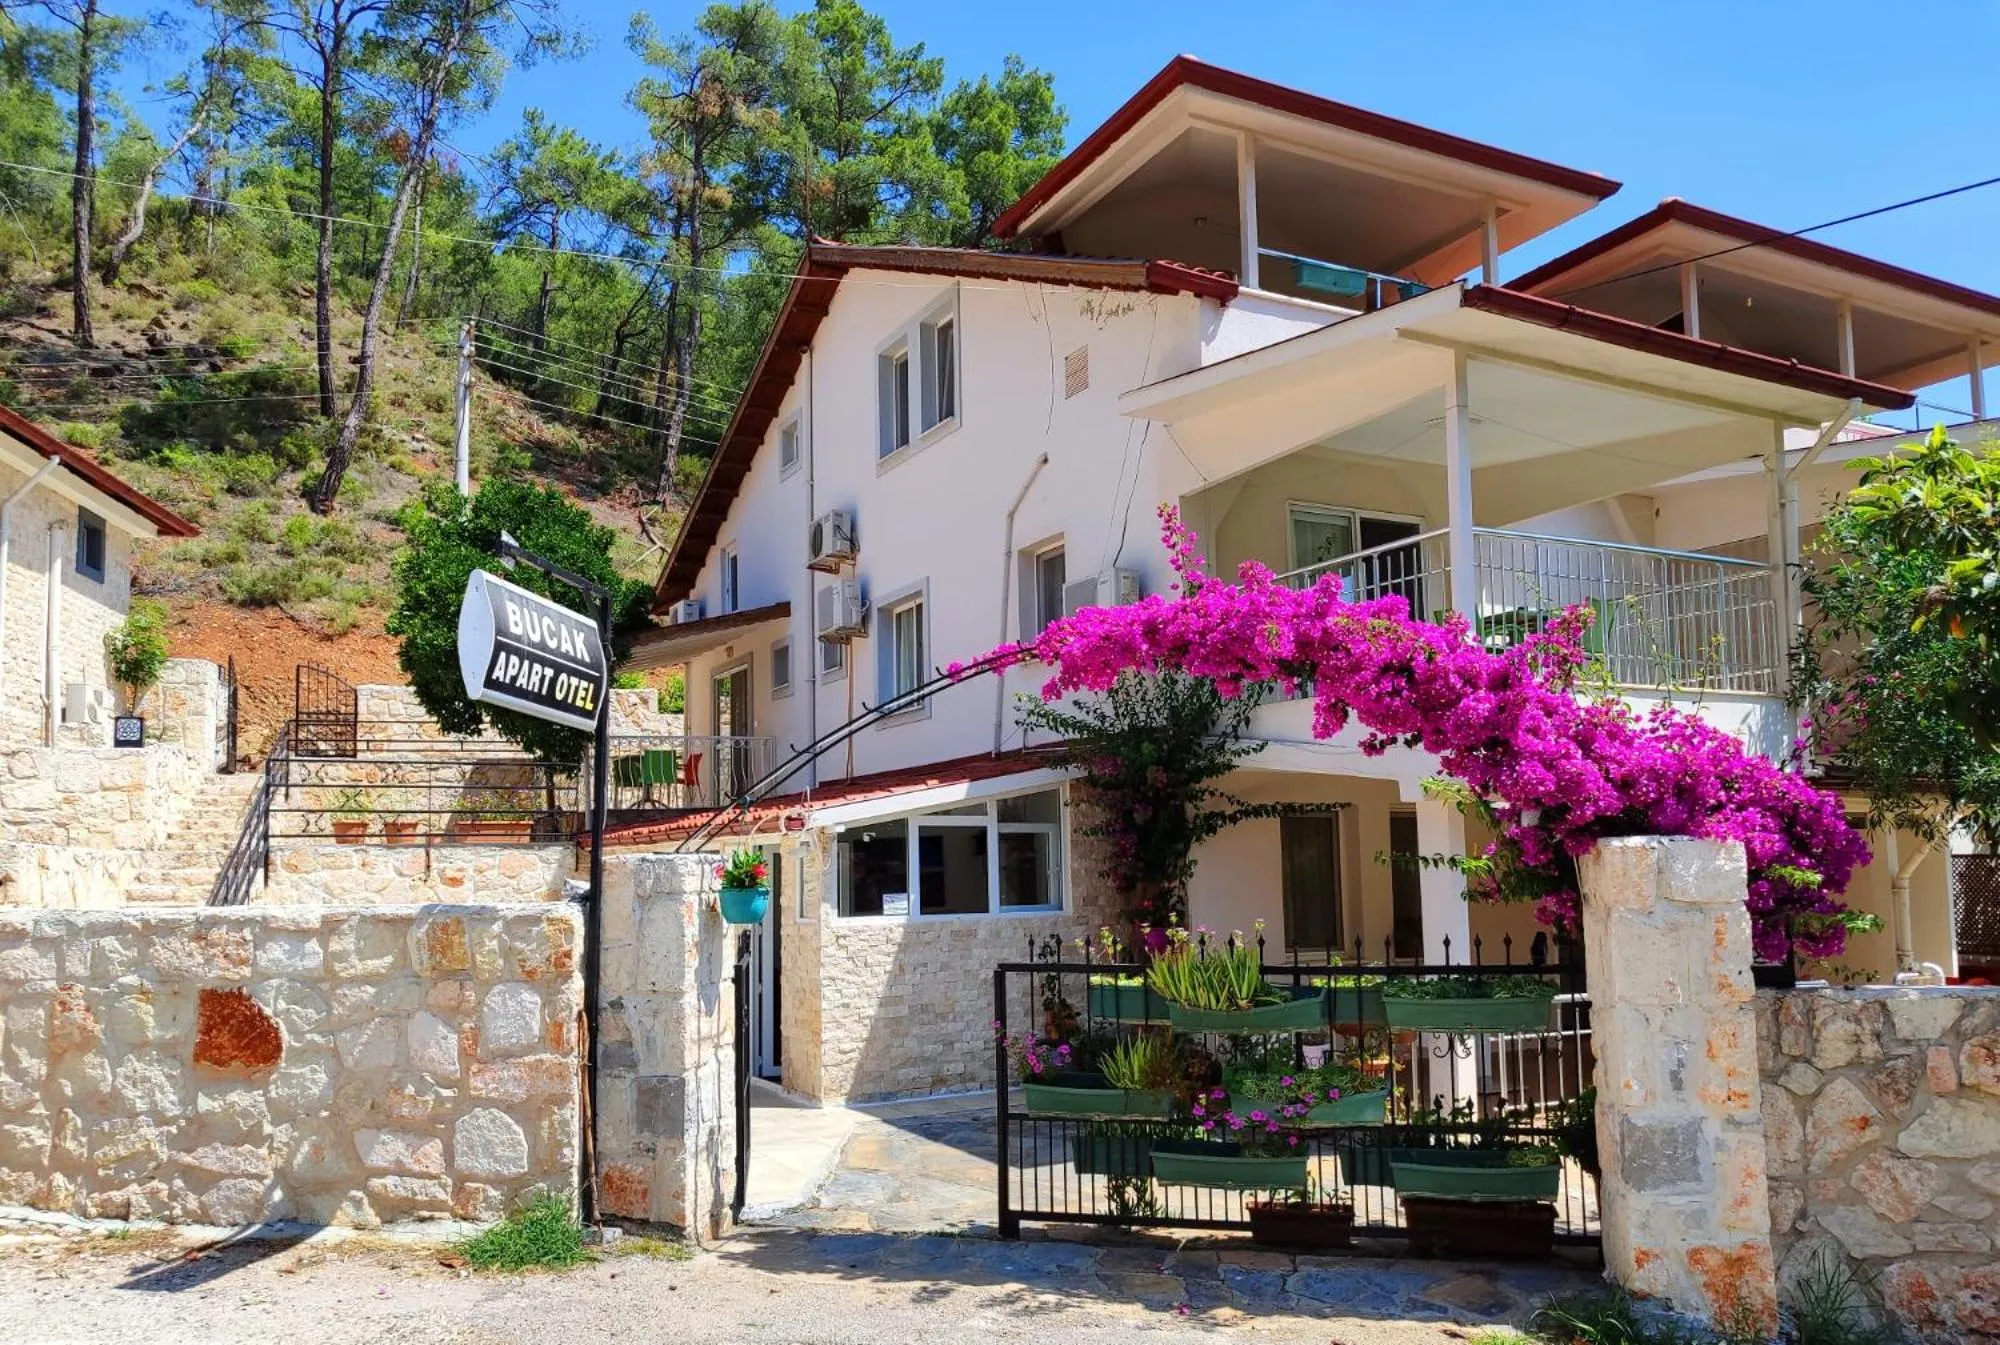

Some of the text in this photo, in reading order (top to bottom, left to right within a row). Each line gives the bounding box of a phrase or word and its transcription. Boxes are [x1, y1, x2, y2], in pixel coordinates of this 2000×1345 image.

[505, 600, 591, 662] BUCAK
[491, 651, 594, 711] APART OTEL
